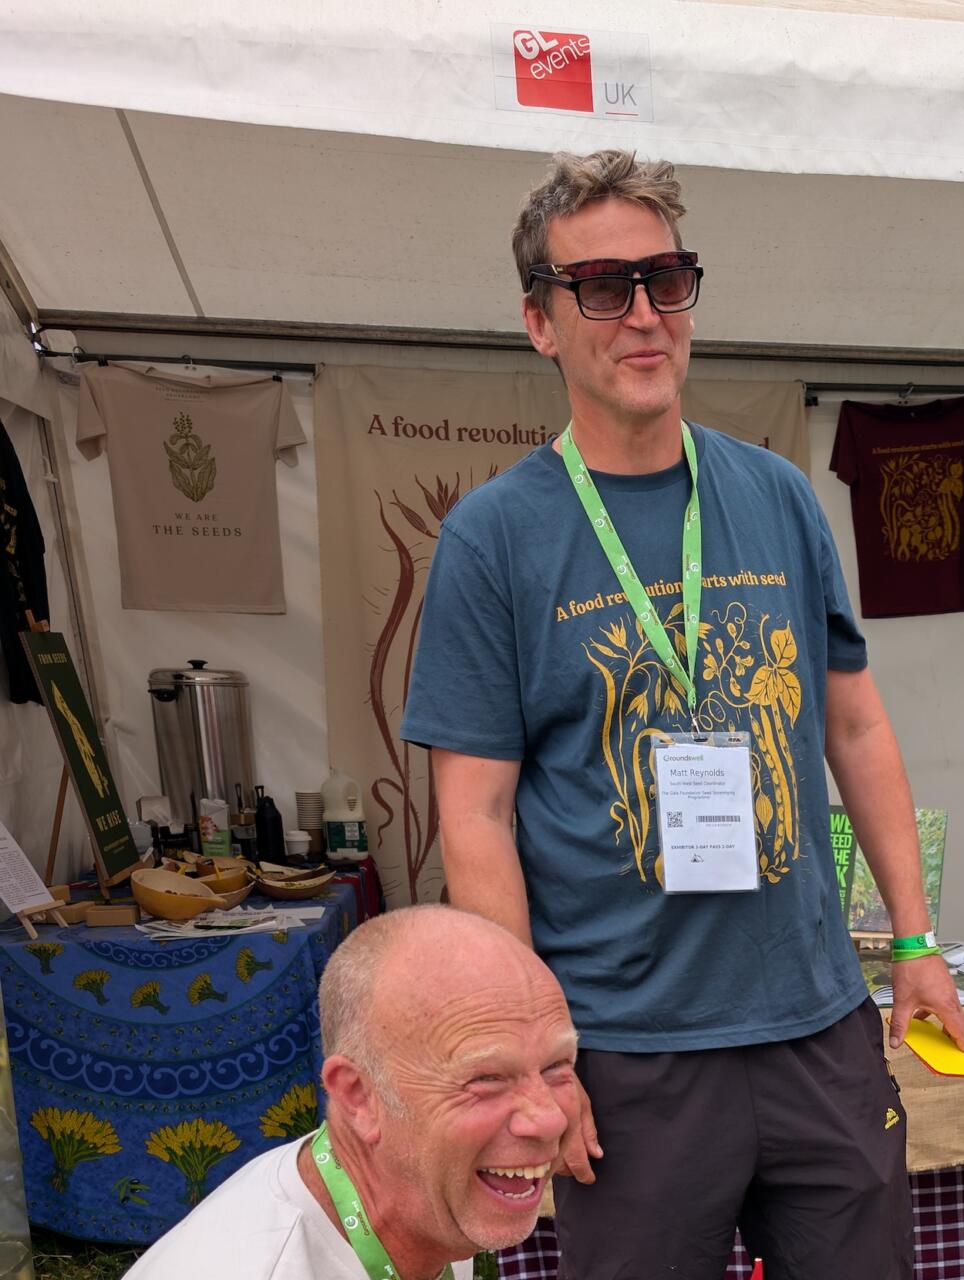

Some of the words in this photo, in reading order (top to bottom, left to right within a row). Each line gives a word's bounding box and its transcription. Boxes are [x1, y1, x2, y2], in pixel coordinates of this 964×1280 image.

[514, 29, 559, 60] GL
[530, 36, 591, 80] events
[604, 82, 637, 106] UK
[367, 413, 387, 435] A
[392, 416, 450, 442] food
[456, 423, 560, 446] revoluti
[175, 512, 192, 521] WE
[196, 513, 218, 522] ARE
[152, 525, 184, 536] THE
[191, 526, 243, 537] SEEDS
[556, 607, 570, 622] A
[568, 594, 602, 616] food
[701, 574, 727, 588] arts
[728, 569, 759, 586] with
[670, 769, 688, 777] Matt
[690, 769, 725, 778] Reynolds
